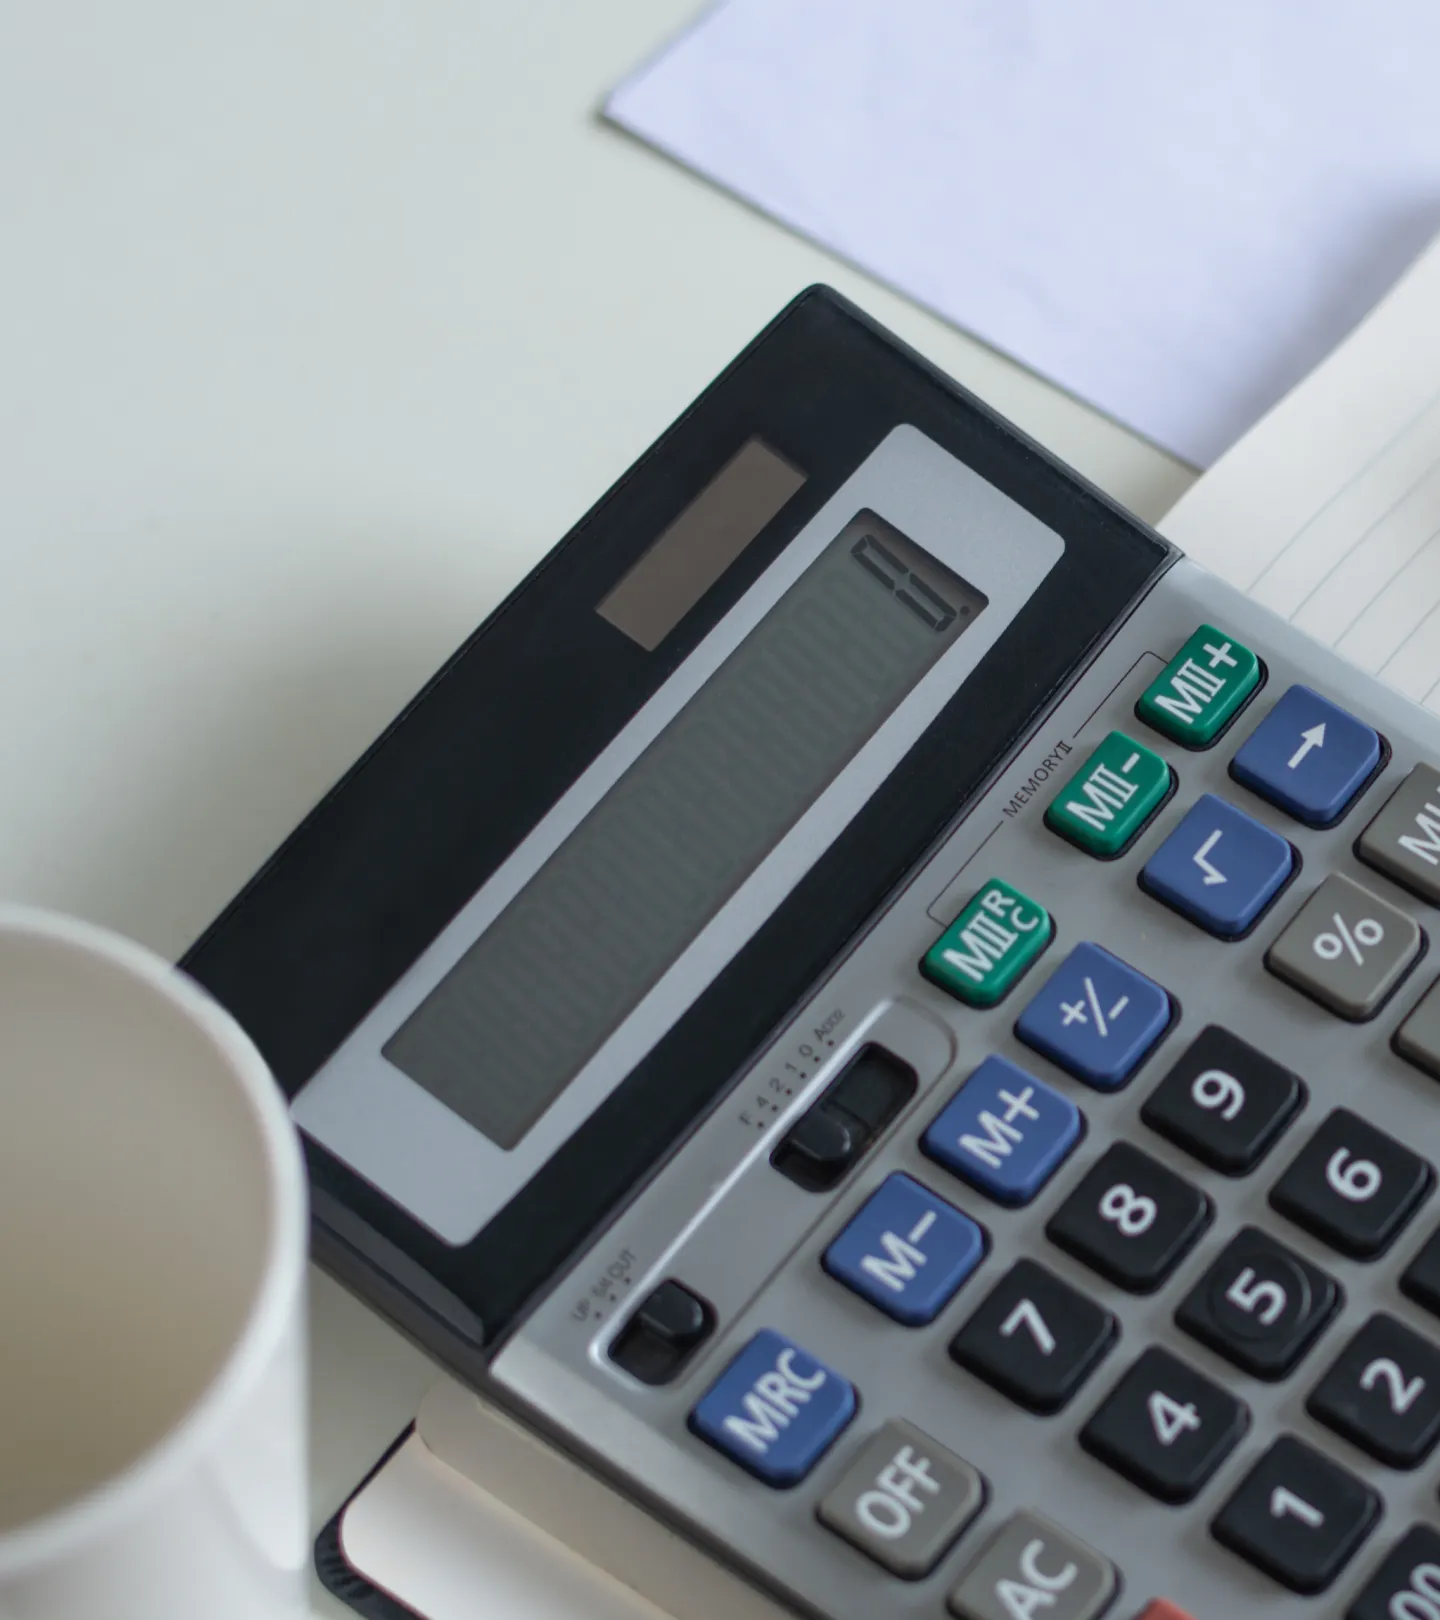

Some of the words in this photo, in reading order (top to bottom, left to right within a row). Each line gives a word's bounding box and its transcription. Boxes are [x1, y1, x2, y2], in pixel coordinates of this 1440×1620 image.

[1313, 913, 1384, 966] %
[1192, 1070, 1245, 1120] 9
[958, 1086, 1040, 1169] M+
[1327, 1148, 1381, 1200] 6
[1099, 1184, 1157, 1235] 8
[1227, 1268, 1286, 1325] 5
[1001, 1299, 1056, 1353] 7
[724, 1349, 825, 1453] MRC
[1360, 1358, 1425, 1413] 2
[1149, 1391, 1200, 1444] 4
[855, 1445, 940, 1539] OFF
[1271, 1486, 1323, 1526] 1
[995, 1539, 1077, 1620] AC
